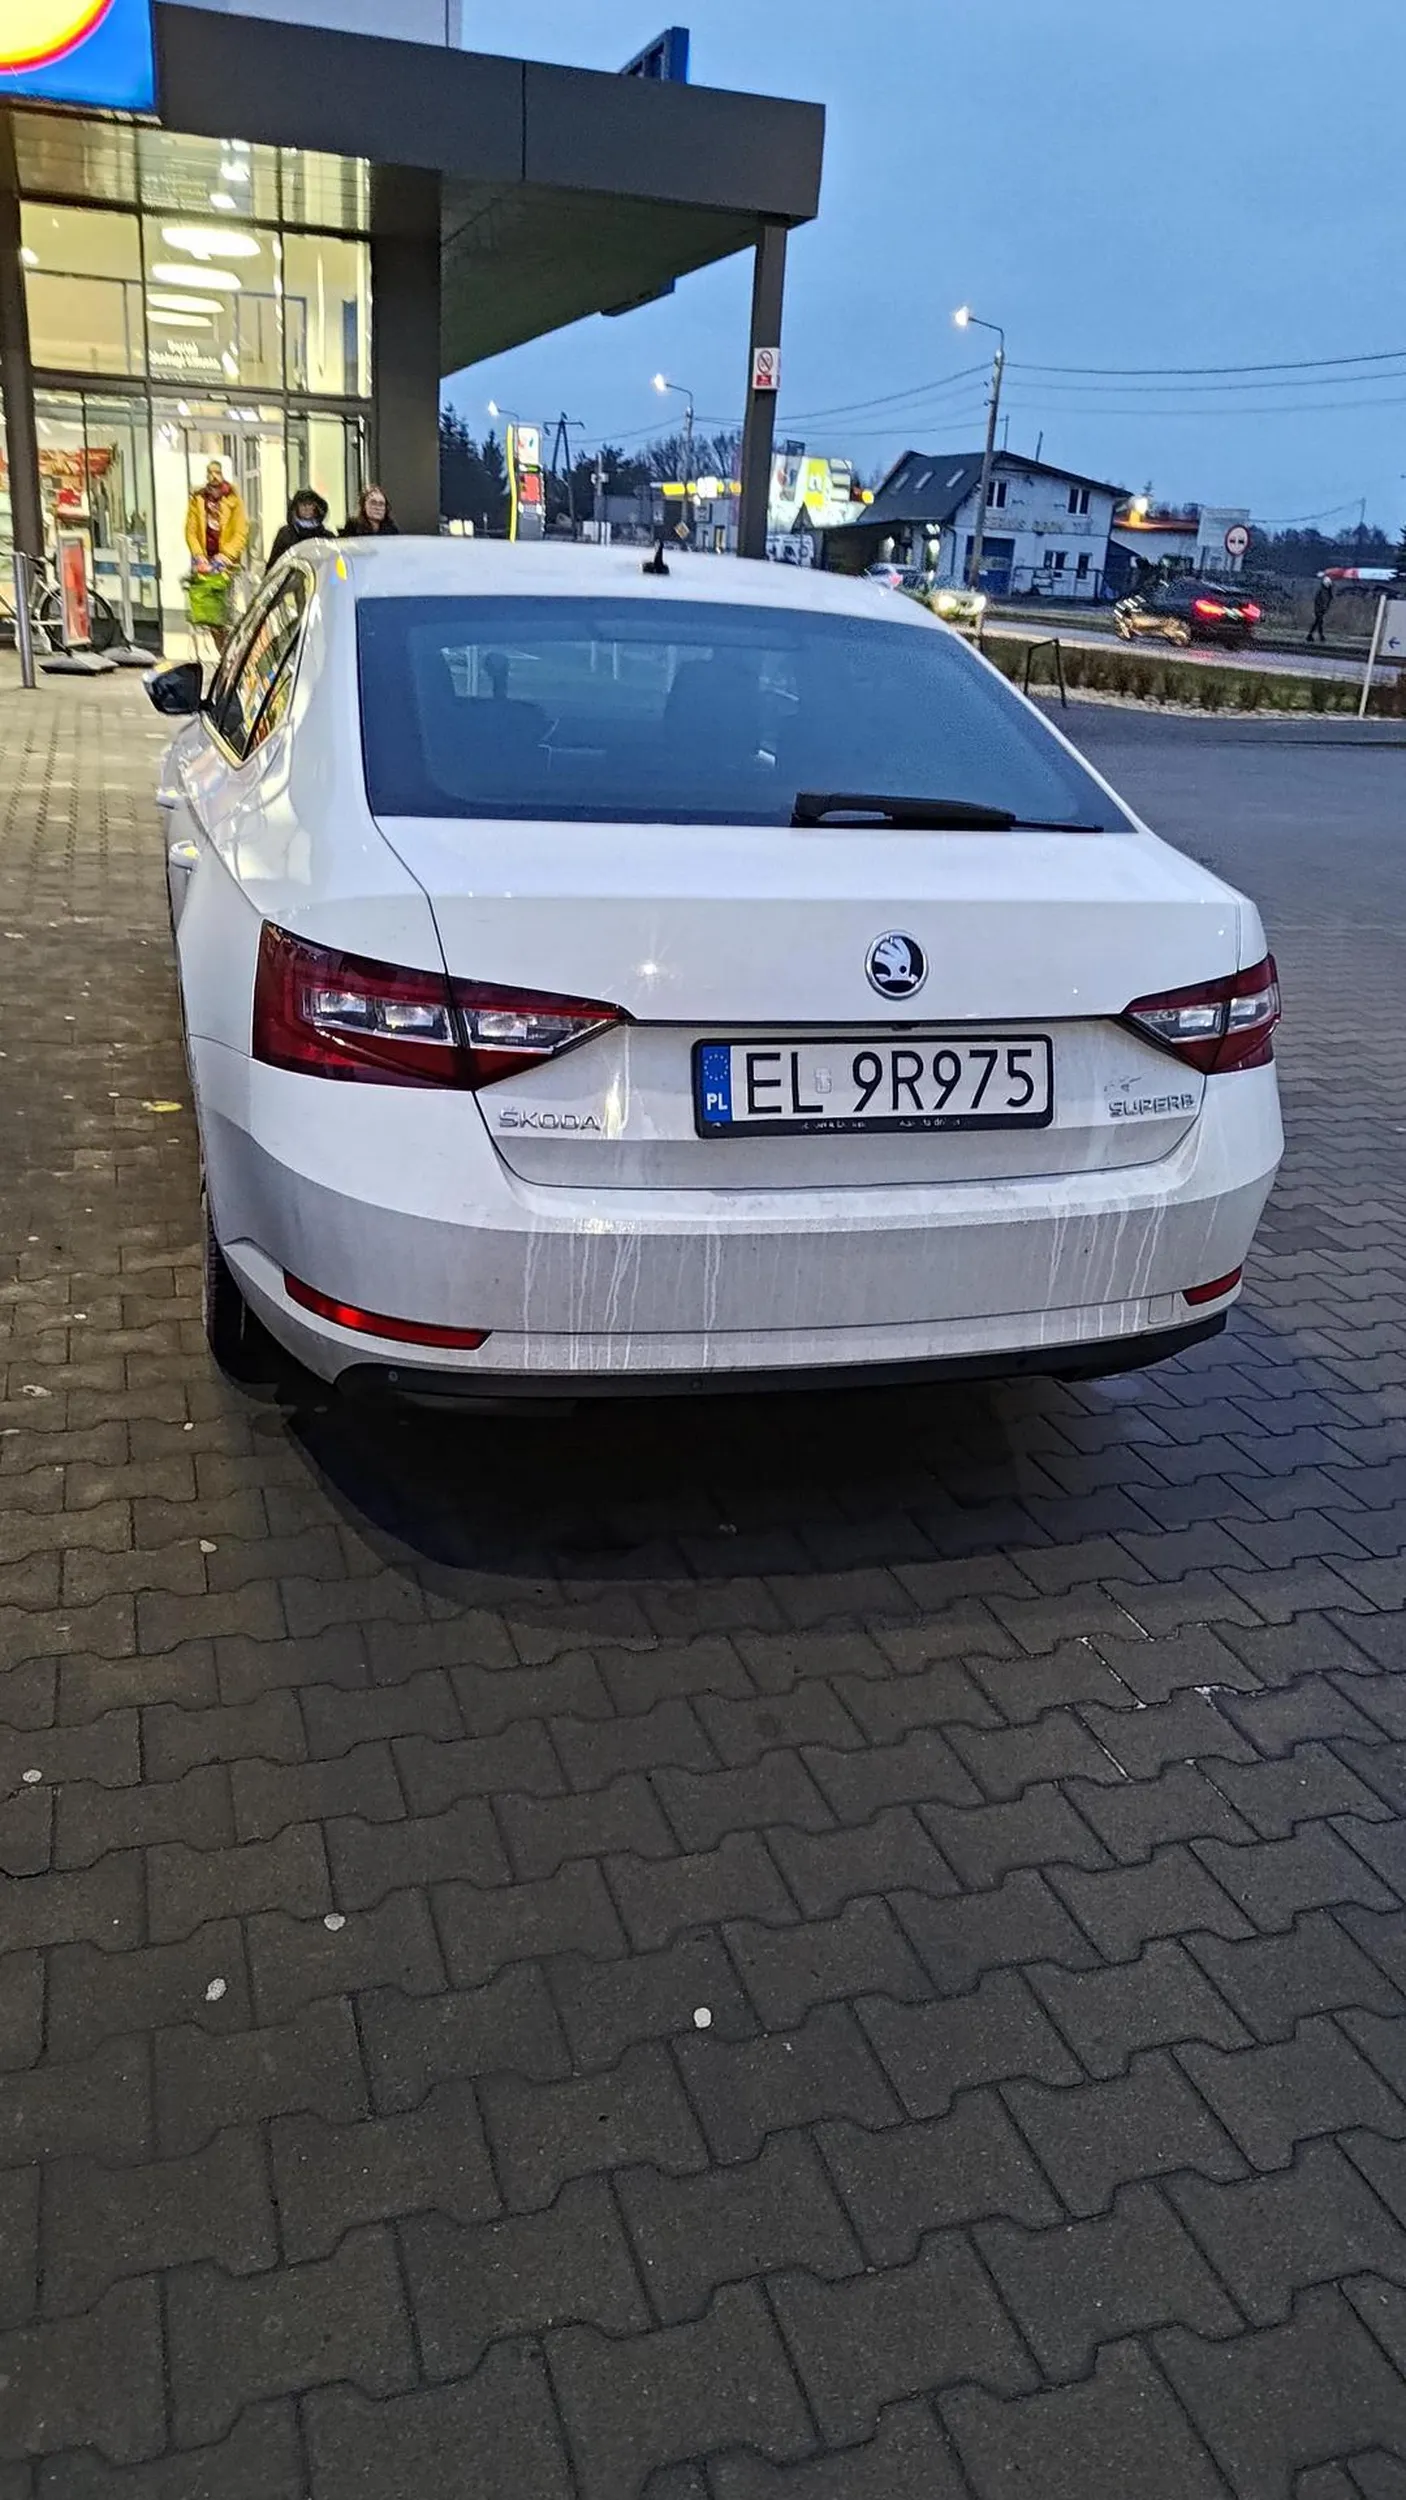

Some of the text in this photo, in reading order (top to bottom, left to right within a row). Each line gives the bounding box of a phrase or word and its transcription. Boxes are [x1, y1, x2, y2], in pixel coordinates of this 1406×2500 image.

[746, 1048, 1035, 1115] EL 9R975
[706, 1092, 729, 1111] PL
[1108, 1094, 1194, 1118] SUPERB
[499, 1105, 602, 1131] ŠKODA
